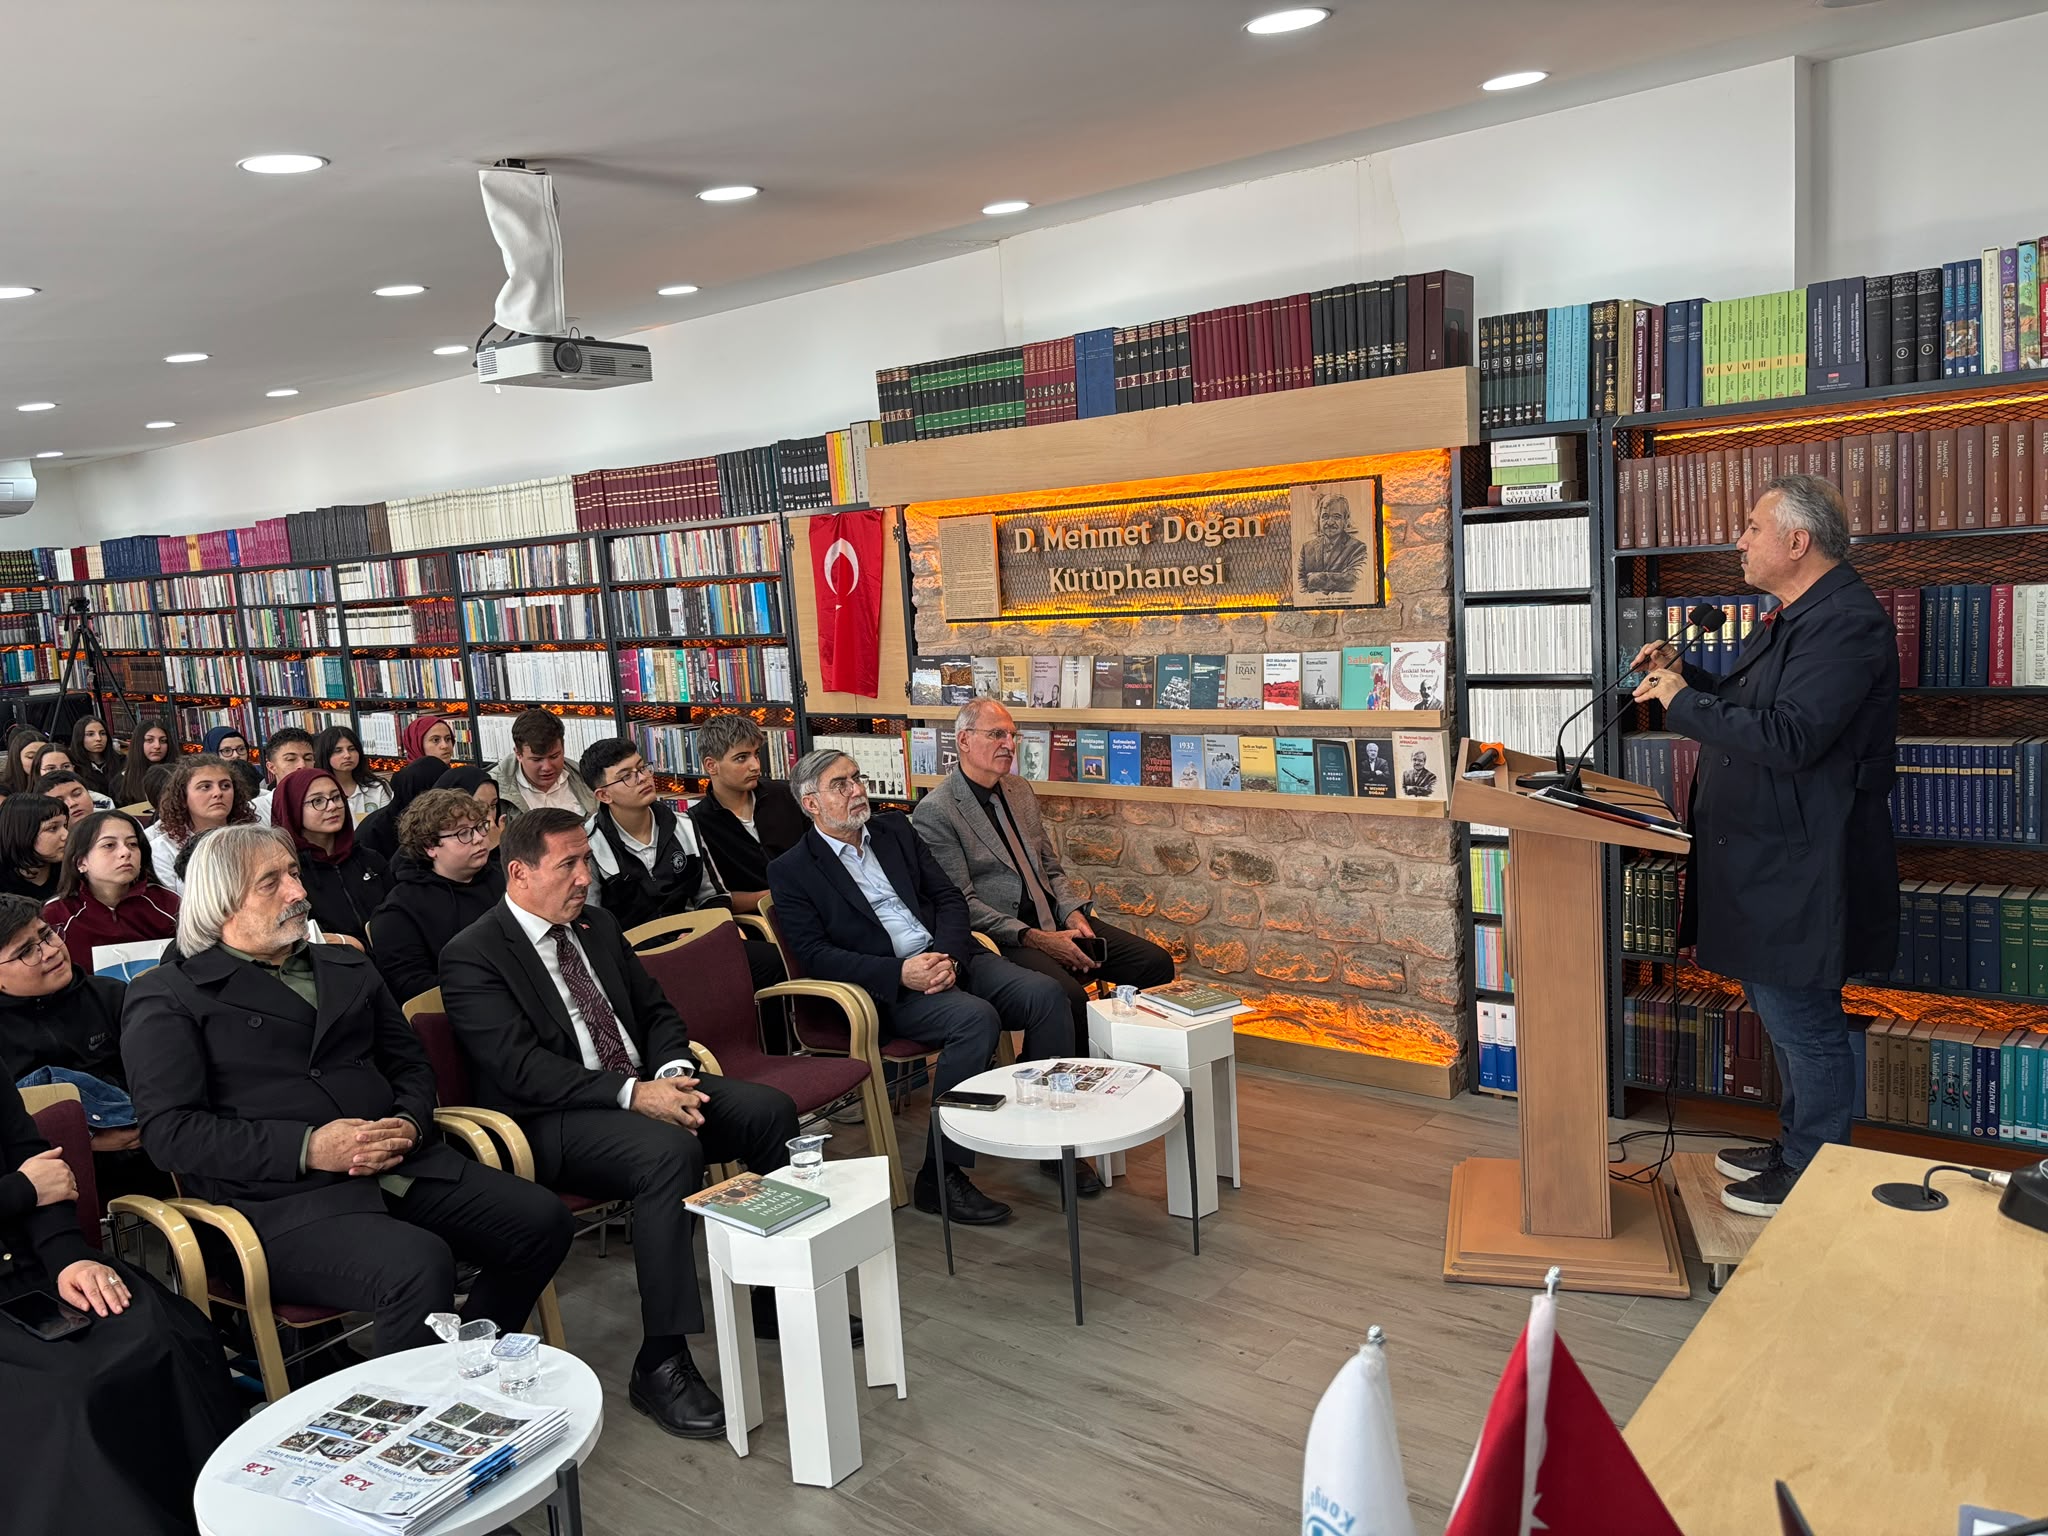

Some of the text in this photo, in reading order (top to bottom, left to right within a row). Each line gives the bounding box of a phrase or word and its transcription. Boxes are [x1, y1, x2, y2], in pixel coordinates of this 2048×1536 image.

[1742, 362, 1750, 370] VI
[1044, 387, 1048, 397] 4
[1050, 385, 1054, 396] 5
[1057, 385, 1061, 395] 6
[1064, 383, 1067, 393] 7
[1070, 382, 1074, 392] 8
[1026, 389, 1029, 399] 1
[1032, 388, 1035, 398] 2
[1038, 387, 1042, 398] 3
[1506, 495, 1548, 504] SÖZLÜĞÜ
[1014, 512, 1264, 554] D. Mehmet Doğan
[1049, 557, 1225, 597] Kütüphanesi
[1347, 656, 1384, 664] Safahat
[1235, 664, 1256, 675] İRAN
[1179, 742, 1194, 750] 1932
[1932, 1052, 1940, 1081] Metafizik
[1947, 1054, 1955, 1083] Metafizik
[1962, 1056, 1970, 1086] Metafizik
[1988, 1080, 1996, 1114] METAFİZİK
[748, 1192, 792, 1213] BULAN
